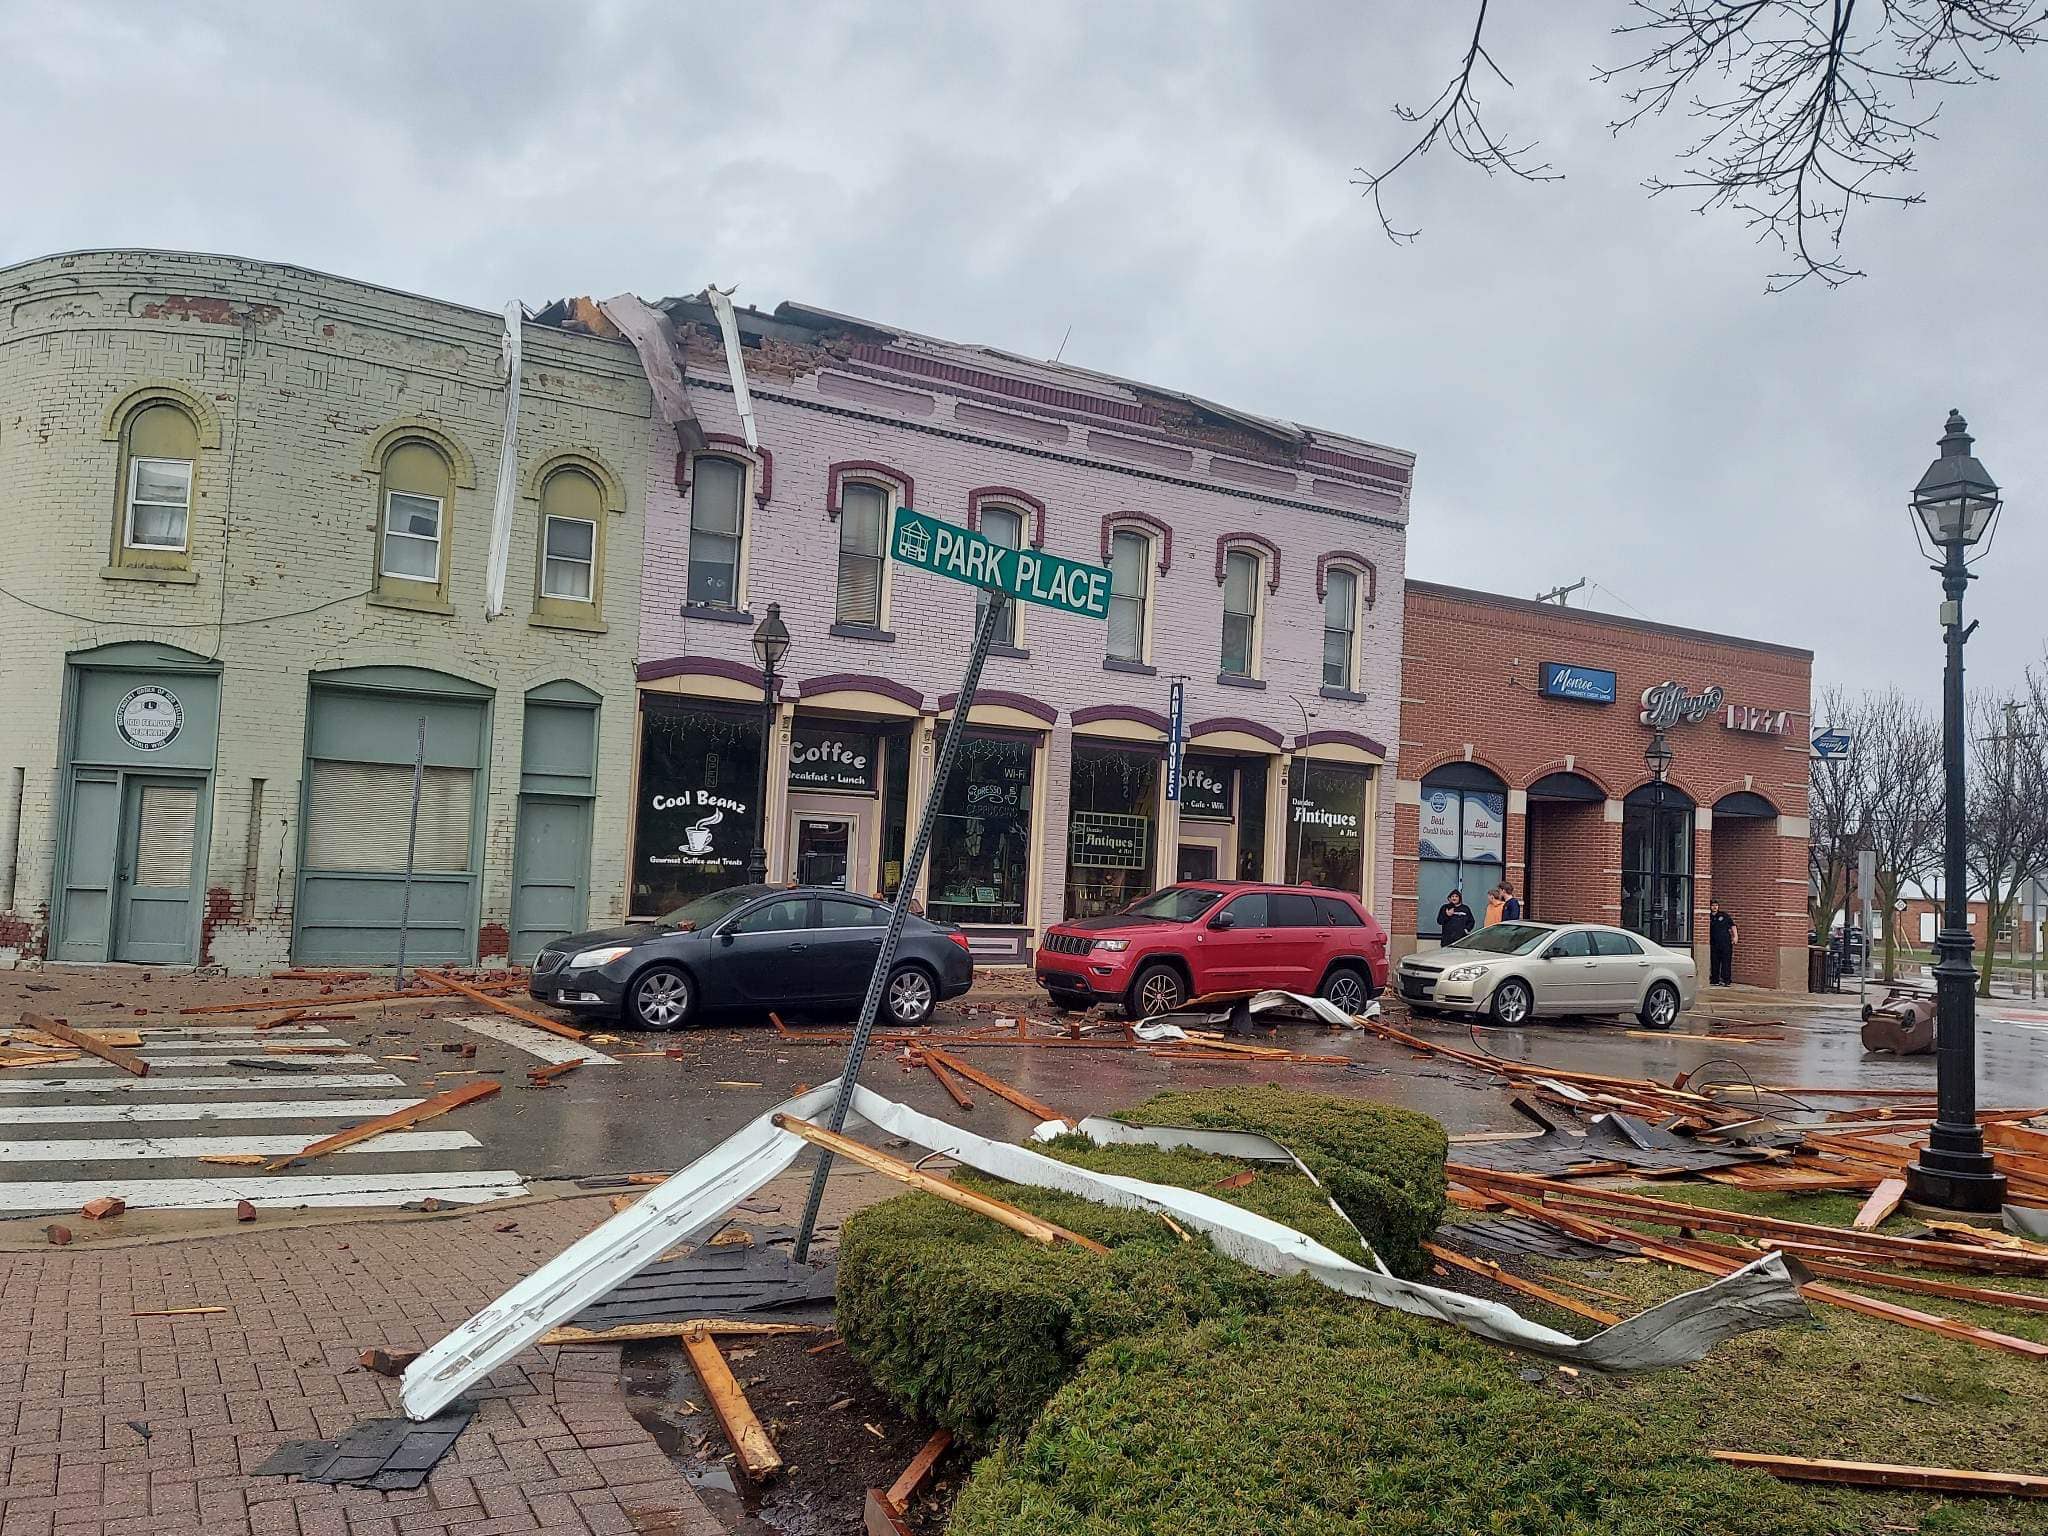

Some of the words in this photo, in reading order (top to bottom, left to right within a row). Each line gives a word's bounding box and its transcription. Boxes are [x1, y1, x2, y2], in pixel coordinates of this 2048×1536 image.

[933, 528, 1006, 587] PARK
[1014, 554, 1107, 612] PLACE
[1552, 669, 1611, 692] Monroe
[136, 687, 156, 695] ORDER
[165, 693, 176, 703] ODD
[1565, 689, 1586, 697] COMMUNITY
[1640, 680, 1724, 728] Tiffany's
[1727, 704, 1796, 736] PIZZA
[1168, 686, 1179, 798] ANTIQUES
[789, 741, 867, 769] Coffee
[838, 773, 865, 785] Lunch
[1180, 769, 1223, 794] offee
[652, 790, 691, 810] Cool
[696, 790, 746, 814] Beanz
[1293, 806, 1356, 828] Antiques
[1431, 816, 1445, 826] Best
[1475, 819, 1489, 828] Best
[1085, 833, 1133, 849] Antiques
[649, 856, 681, 865] Gourmet
[682, 856, 705, 865] Coffee
[706, 858, 720, 866] and
[722, 857, 742, 866] Treats
